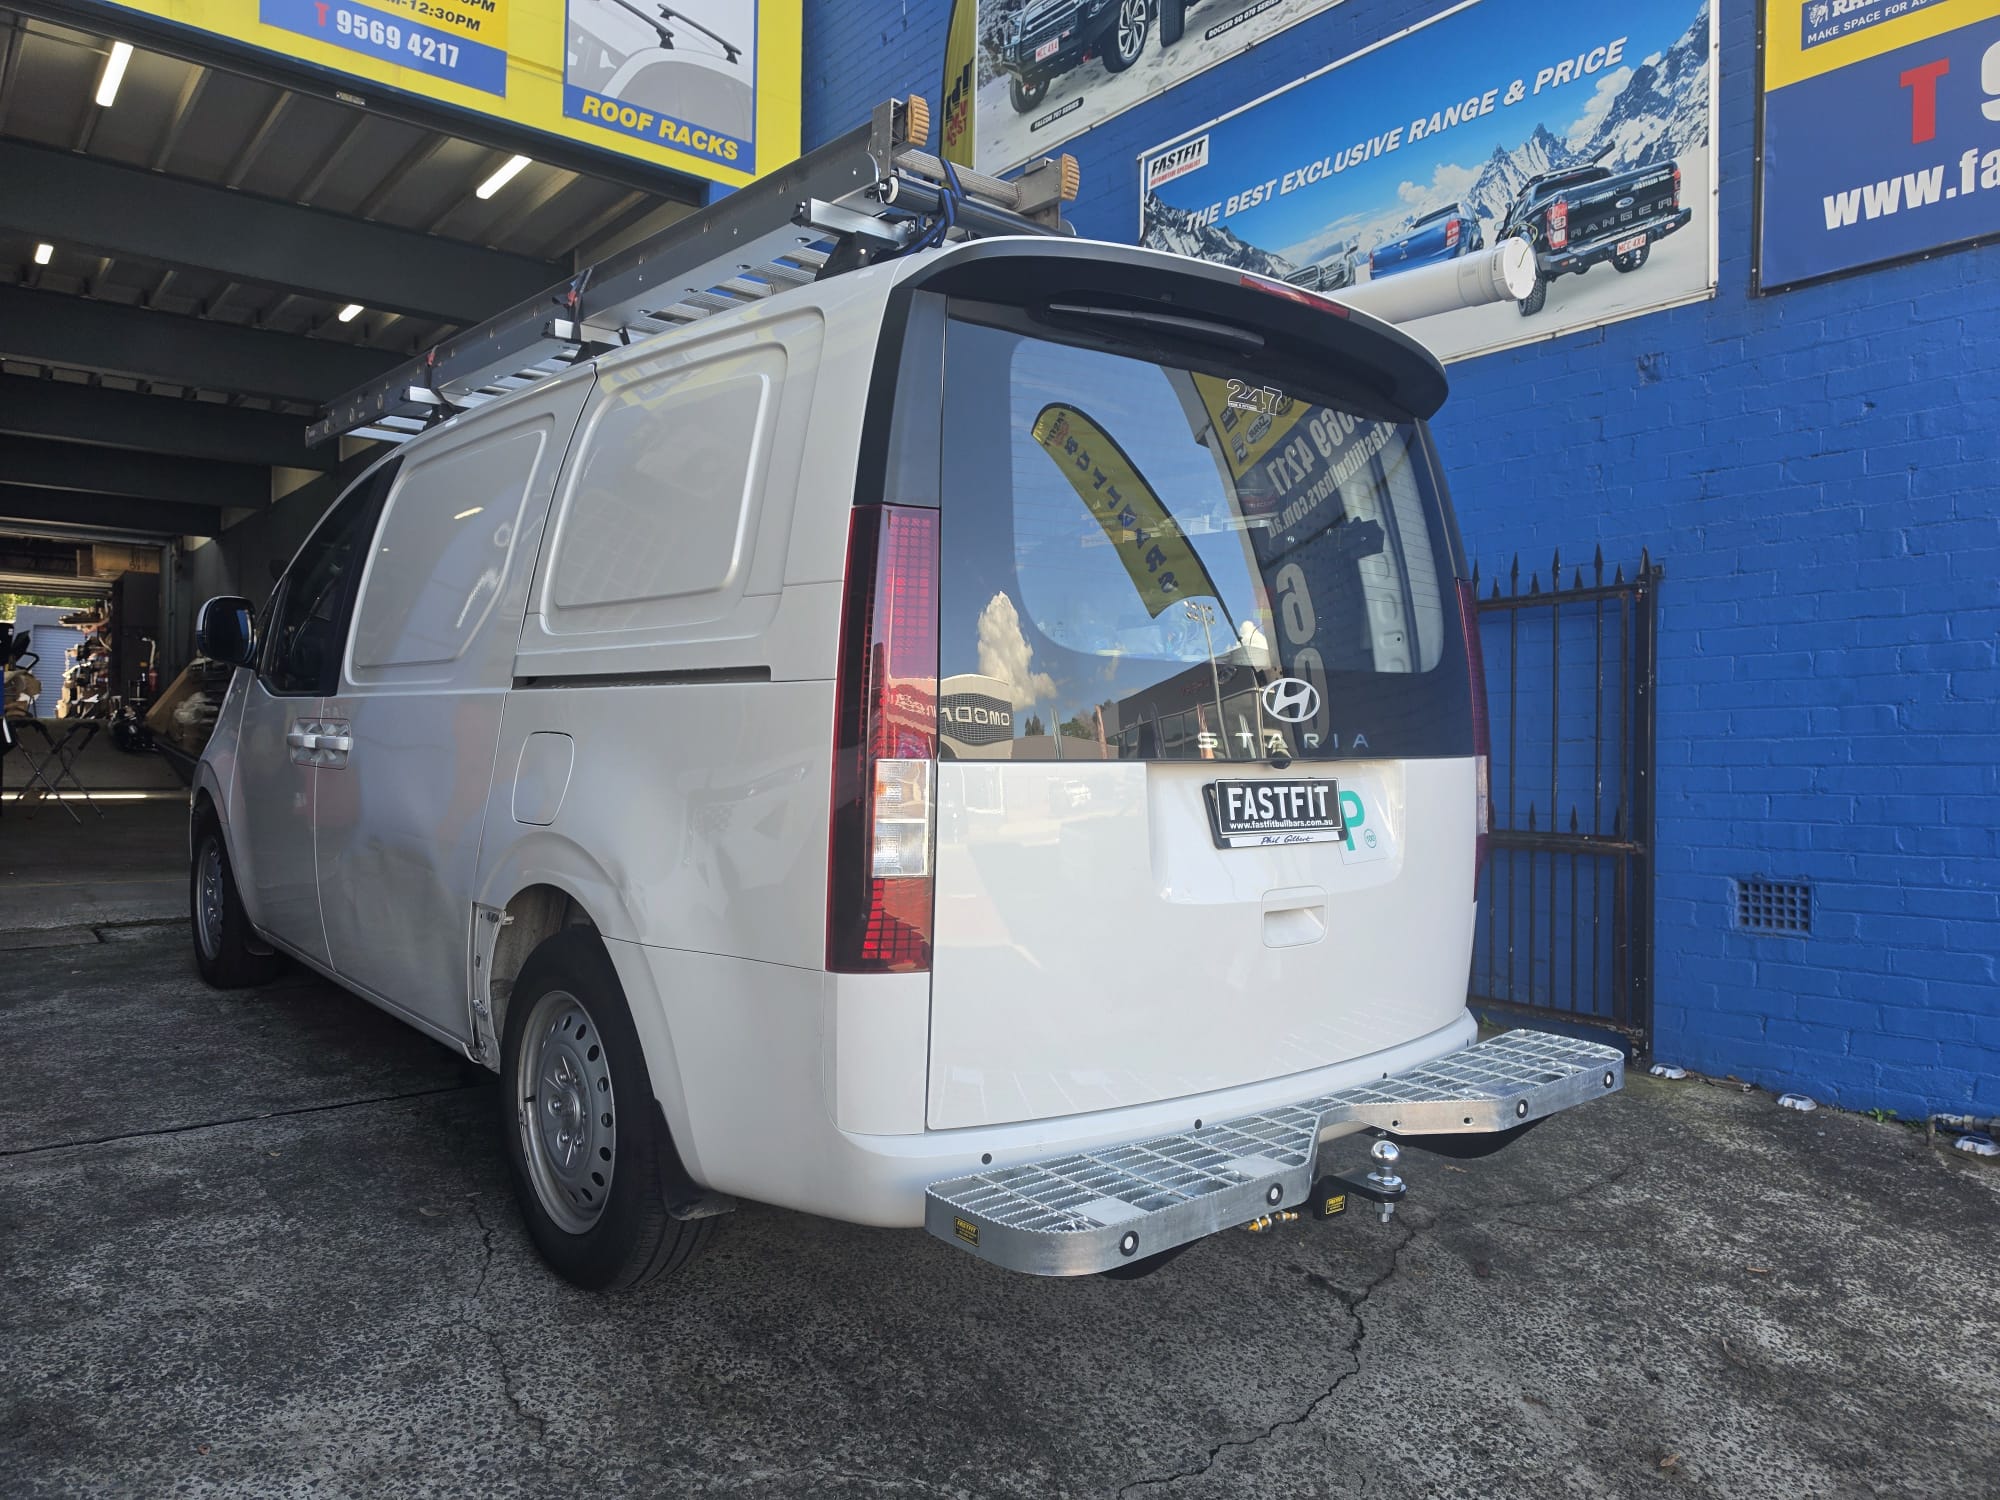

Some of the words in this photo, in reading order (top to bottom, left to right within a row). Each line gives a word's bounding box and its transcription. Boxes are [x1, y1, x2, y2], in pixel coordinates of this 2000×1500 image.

[315, 2, 330, 27] T
[336, 9, 401, 50] 9569
[407, 33, 459, 68] 4217
[1808, 25, 1840, 43] MAKE
[1843, 11, 1881, 31] SPACE
[1885, 1, 1908, 16] FOR
[1900, 56, 1950, 144] T
[582, 95, 654, 131] ROOF
[658, 119, 739, 160] RACKS
[1186, 202, 1222, 233] THE
[1224, 179, 1278, 218] BEST
[1280, 127, 1404, 195] EXCLUSIVE
[1407, 88, 1498, 144] RANGE
[1503, 79, 1526, 105] &
[1533, 36, 1628, 95] PRICE
[1151, 138, 1206, 177] FASTFIT
[1571, 197, 1673, 239] RANGER
[1227, 379, 1282, 416] 247
[1198, 732, 1370, 750] STARIA
[1227, 785, 1329, 821] FASTFIT
[1229, 818, 1333, 830] www.fastfitbullbars.com.au
[1338, 790, 1366, 851] P
